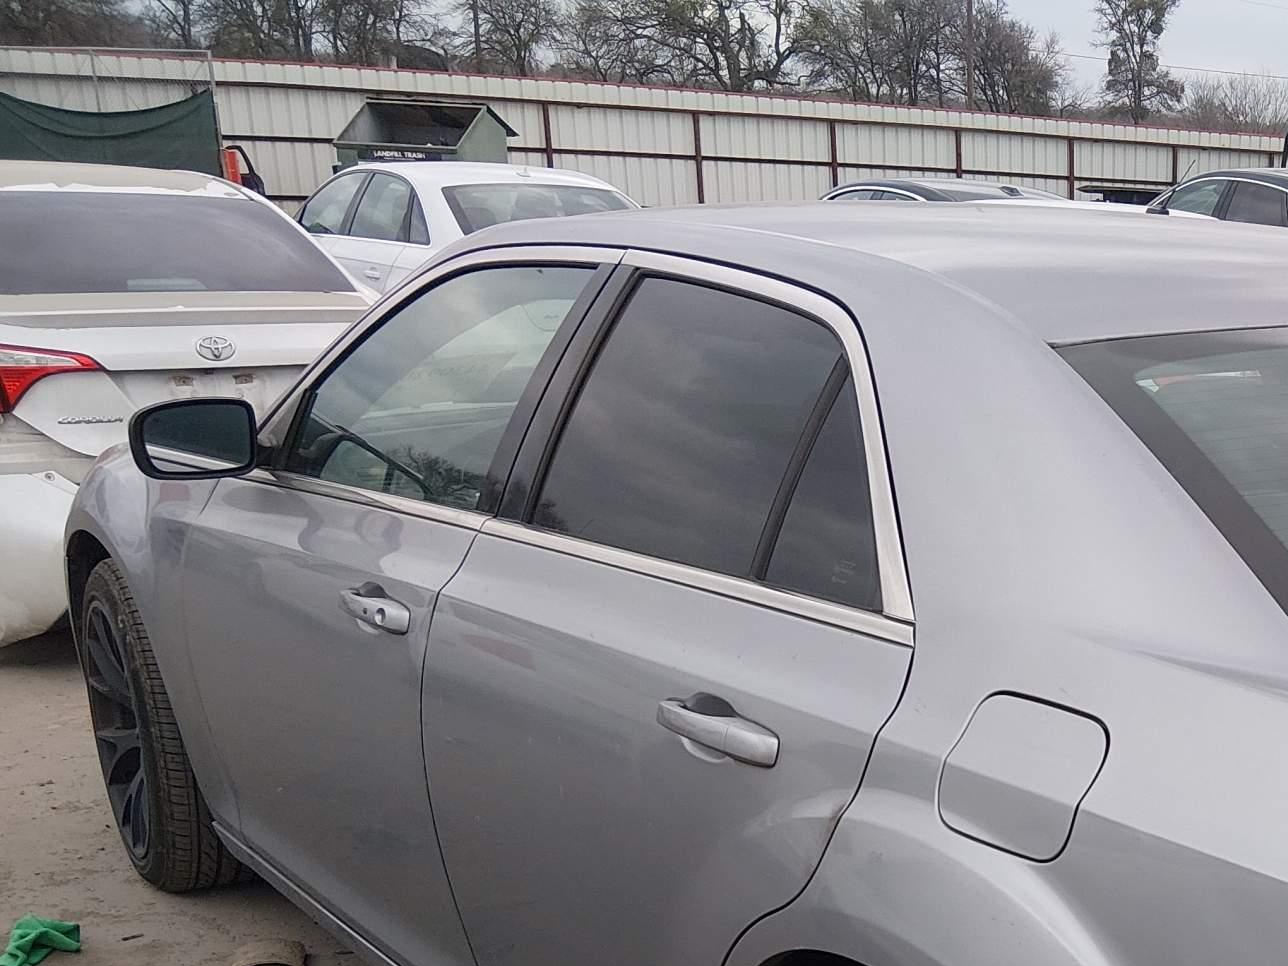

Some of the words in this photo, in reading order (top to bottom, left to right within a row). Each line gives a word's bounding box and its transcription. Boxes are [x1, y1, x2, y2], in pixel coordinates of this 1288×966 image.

[373, 150, 403, 158] LANDFILL
[404, 151, 426, 160] TRASH
[57, 415, 123, 425] COROLLA
